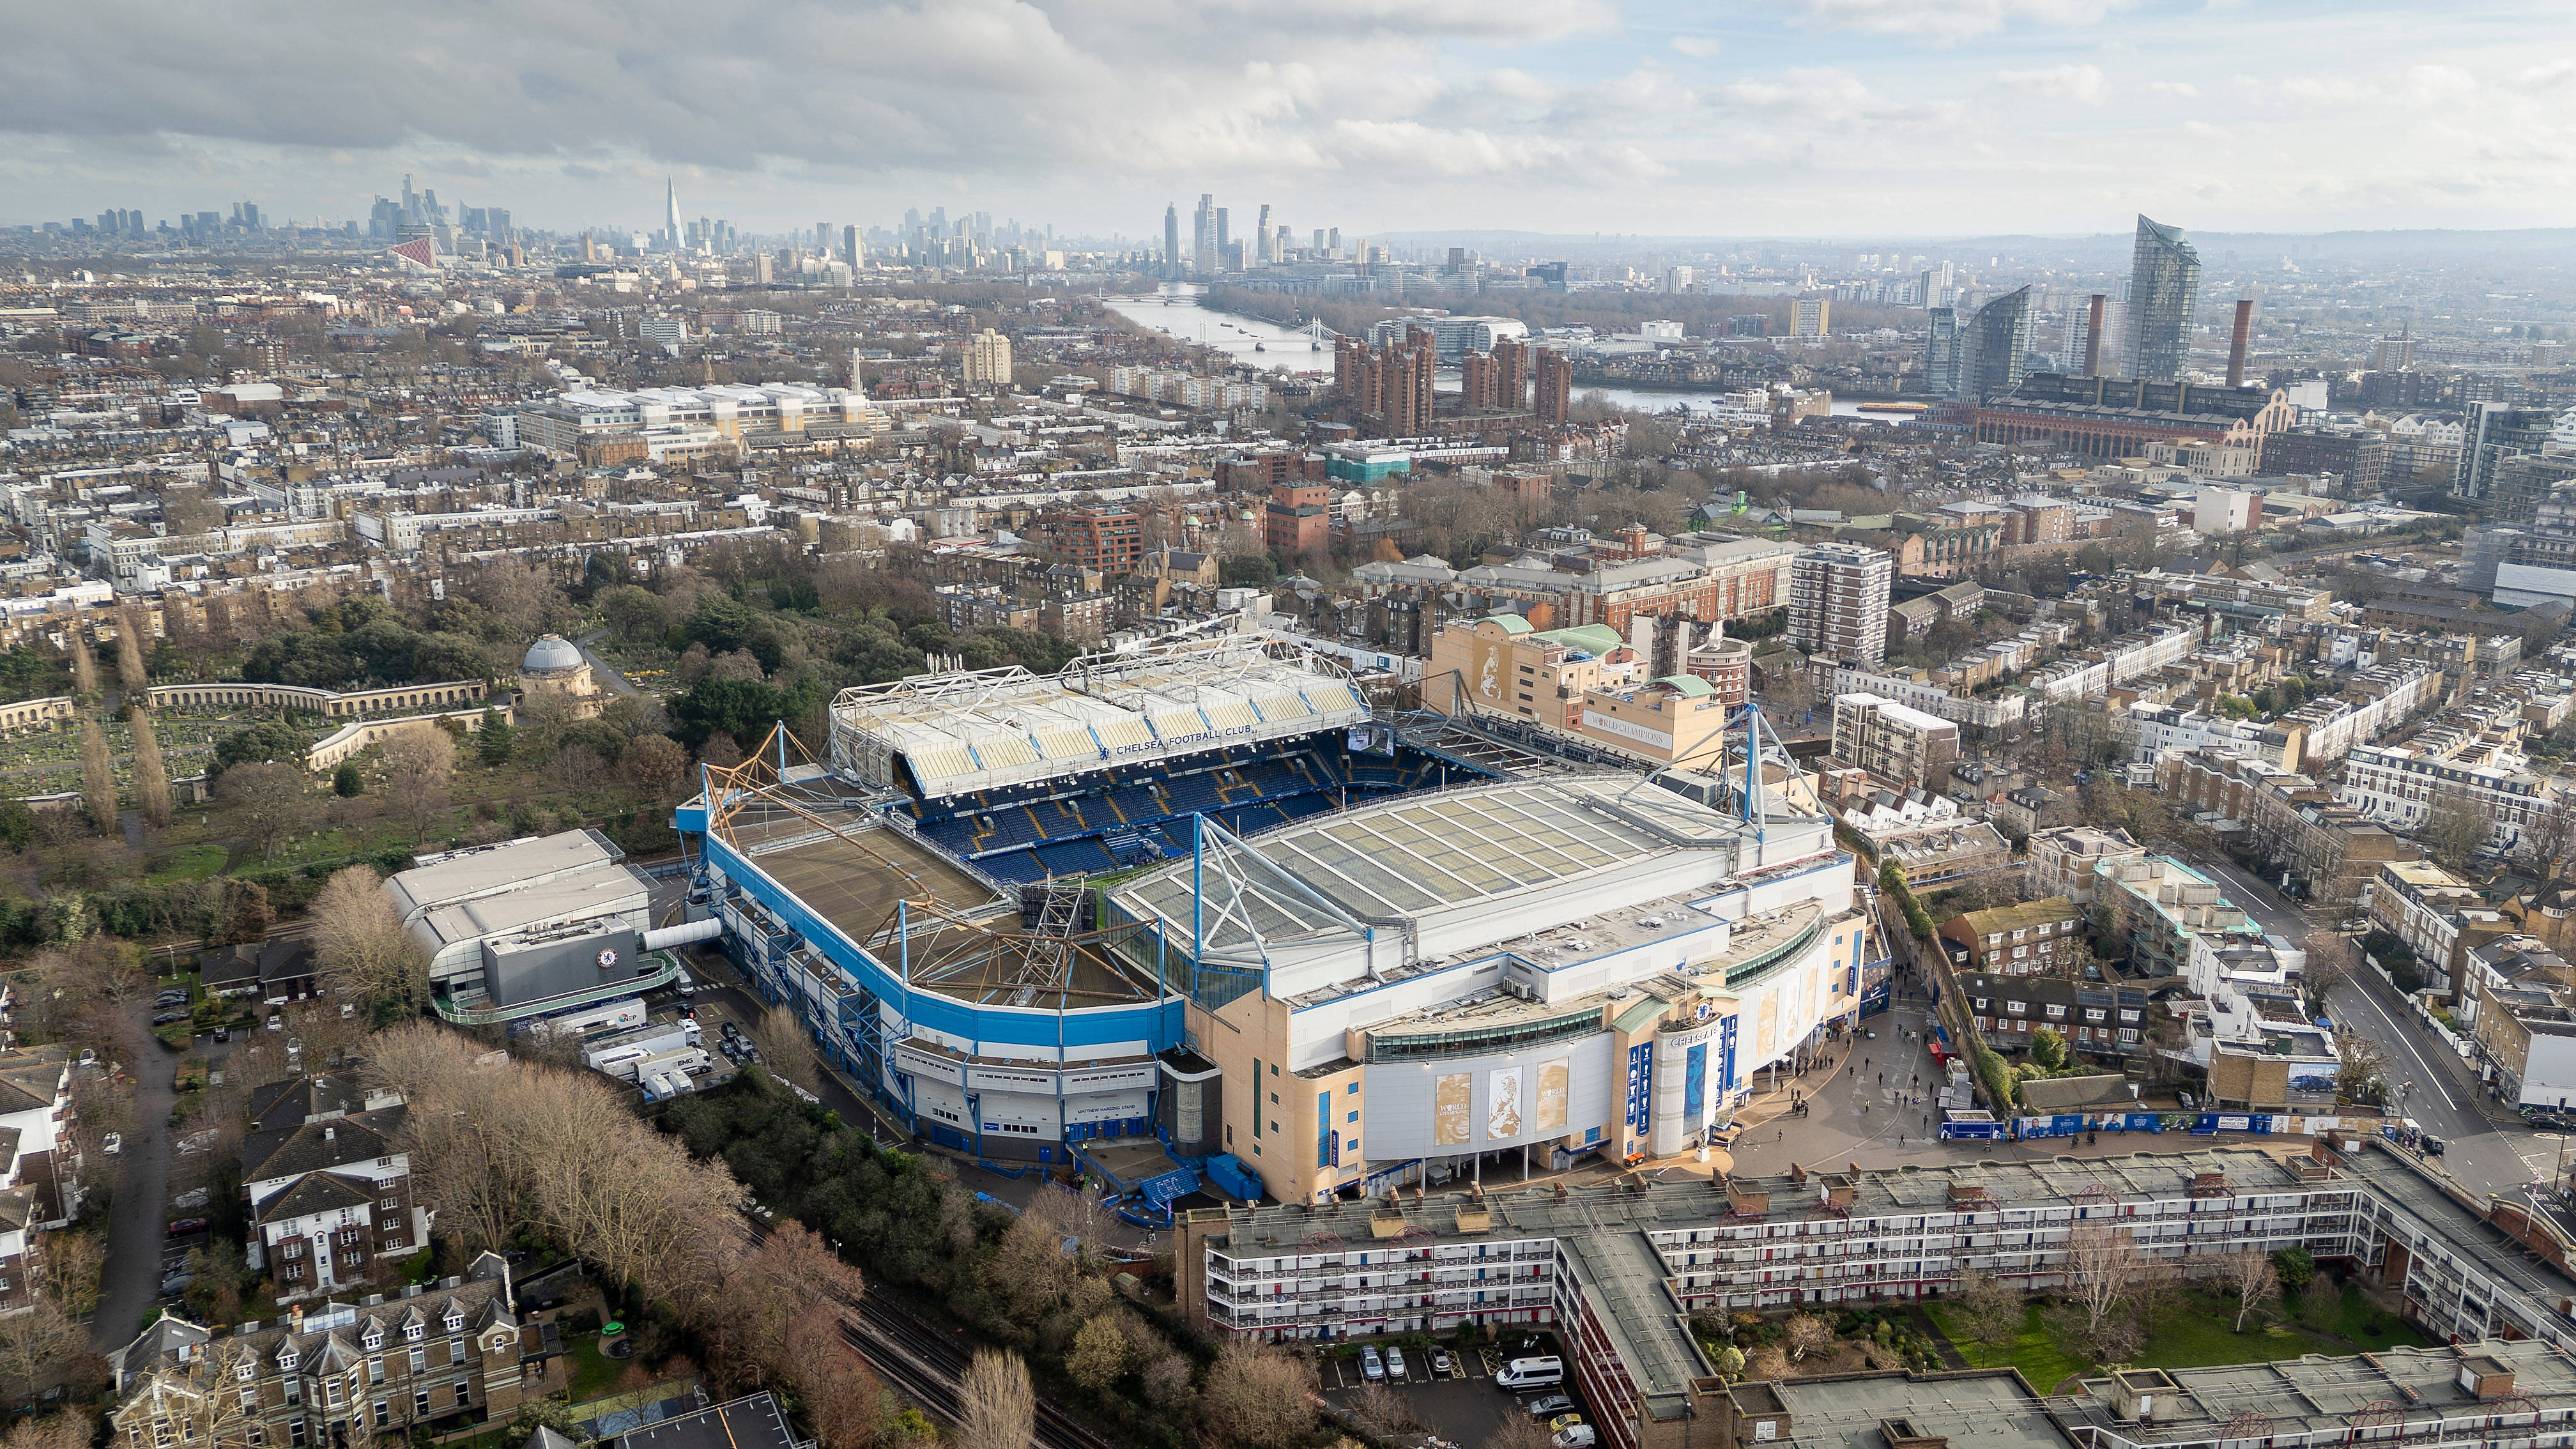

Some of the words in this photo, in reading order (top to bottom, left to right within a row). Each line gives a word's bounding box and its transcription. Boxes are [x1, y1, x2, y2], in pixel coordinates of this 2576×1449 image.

[1591, 715, 1618, 730] WORLD
[1619, 723, 1664, 743] CHAMPIONS
[1117, 739, 1164, 755] CHELSEA
[1169, 730, 1220, 746] FOOTBALL
[1225, 725, 1251, 736] CLUB
[1671, 1031, 1710, 1047] CHELSEA
[677, 1058, 694, 1066] EMG
[1440, 1103, 1468, 1111] WORLD
